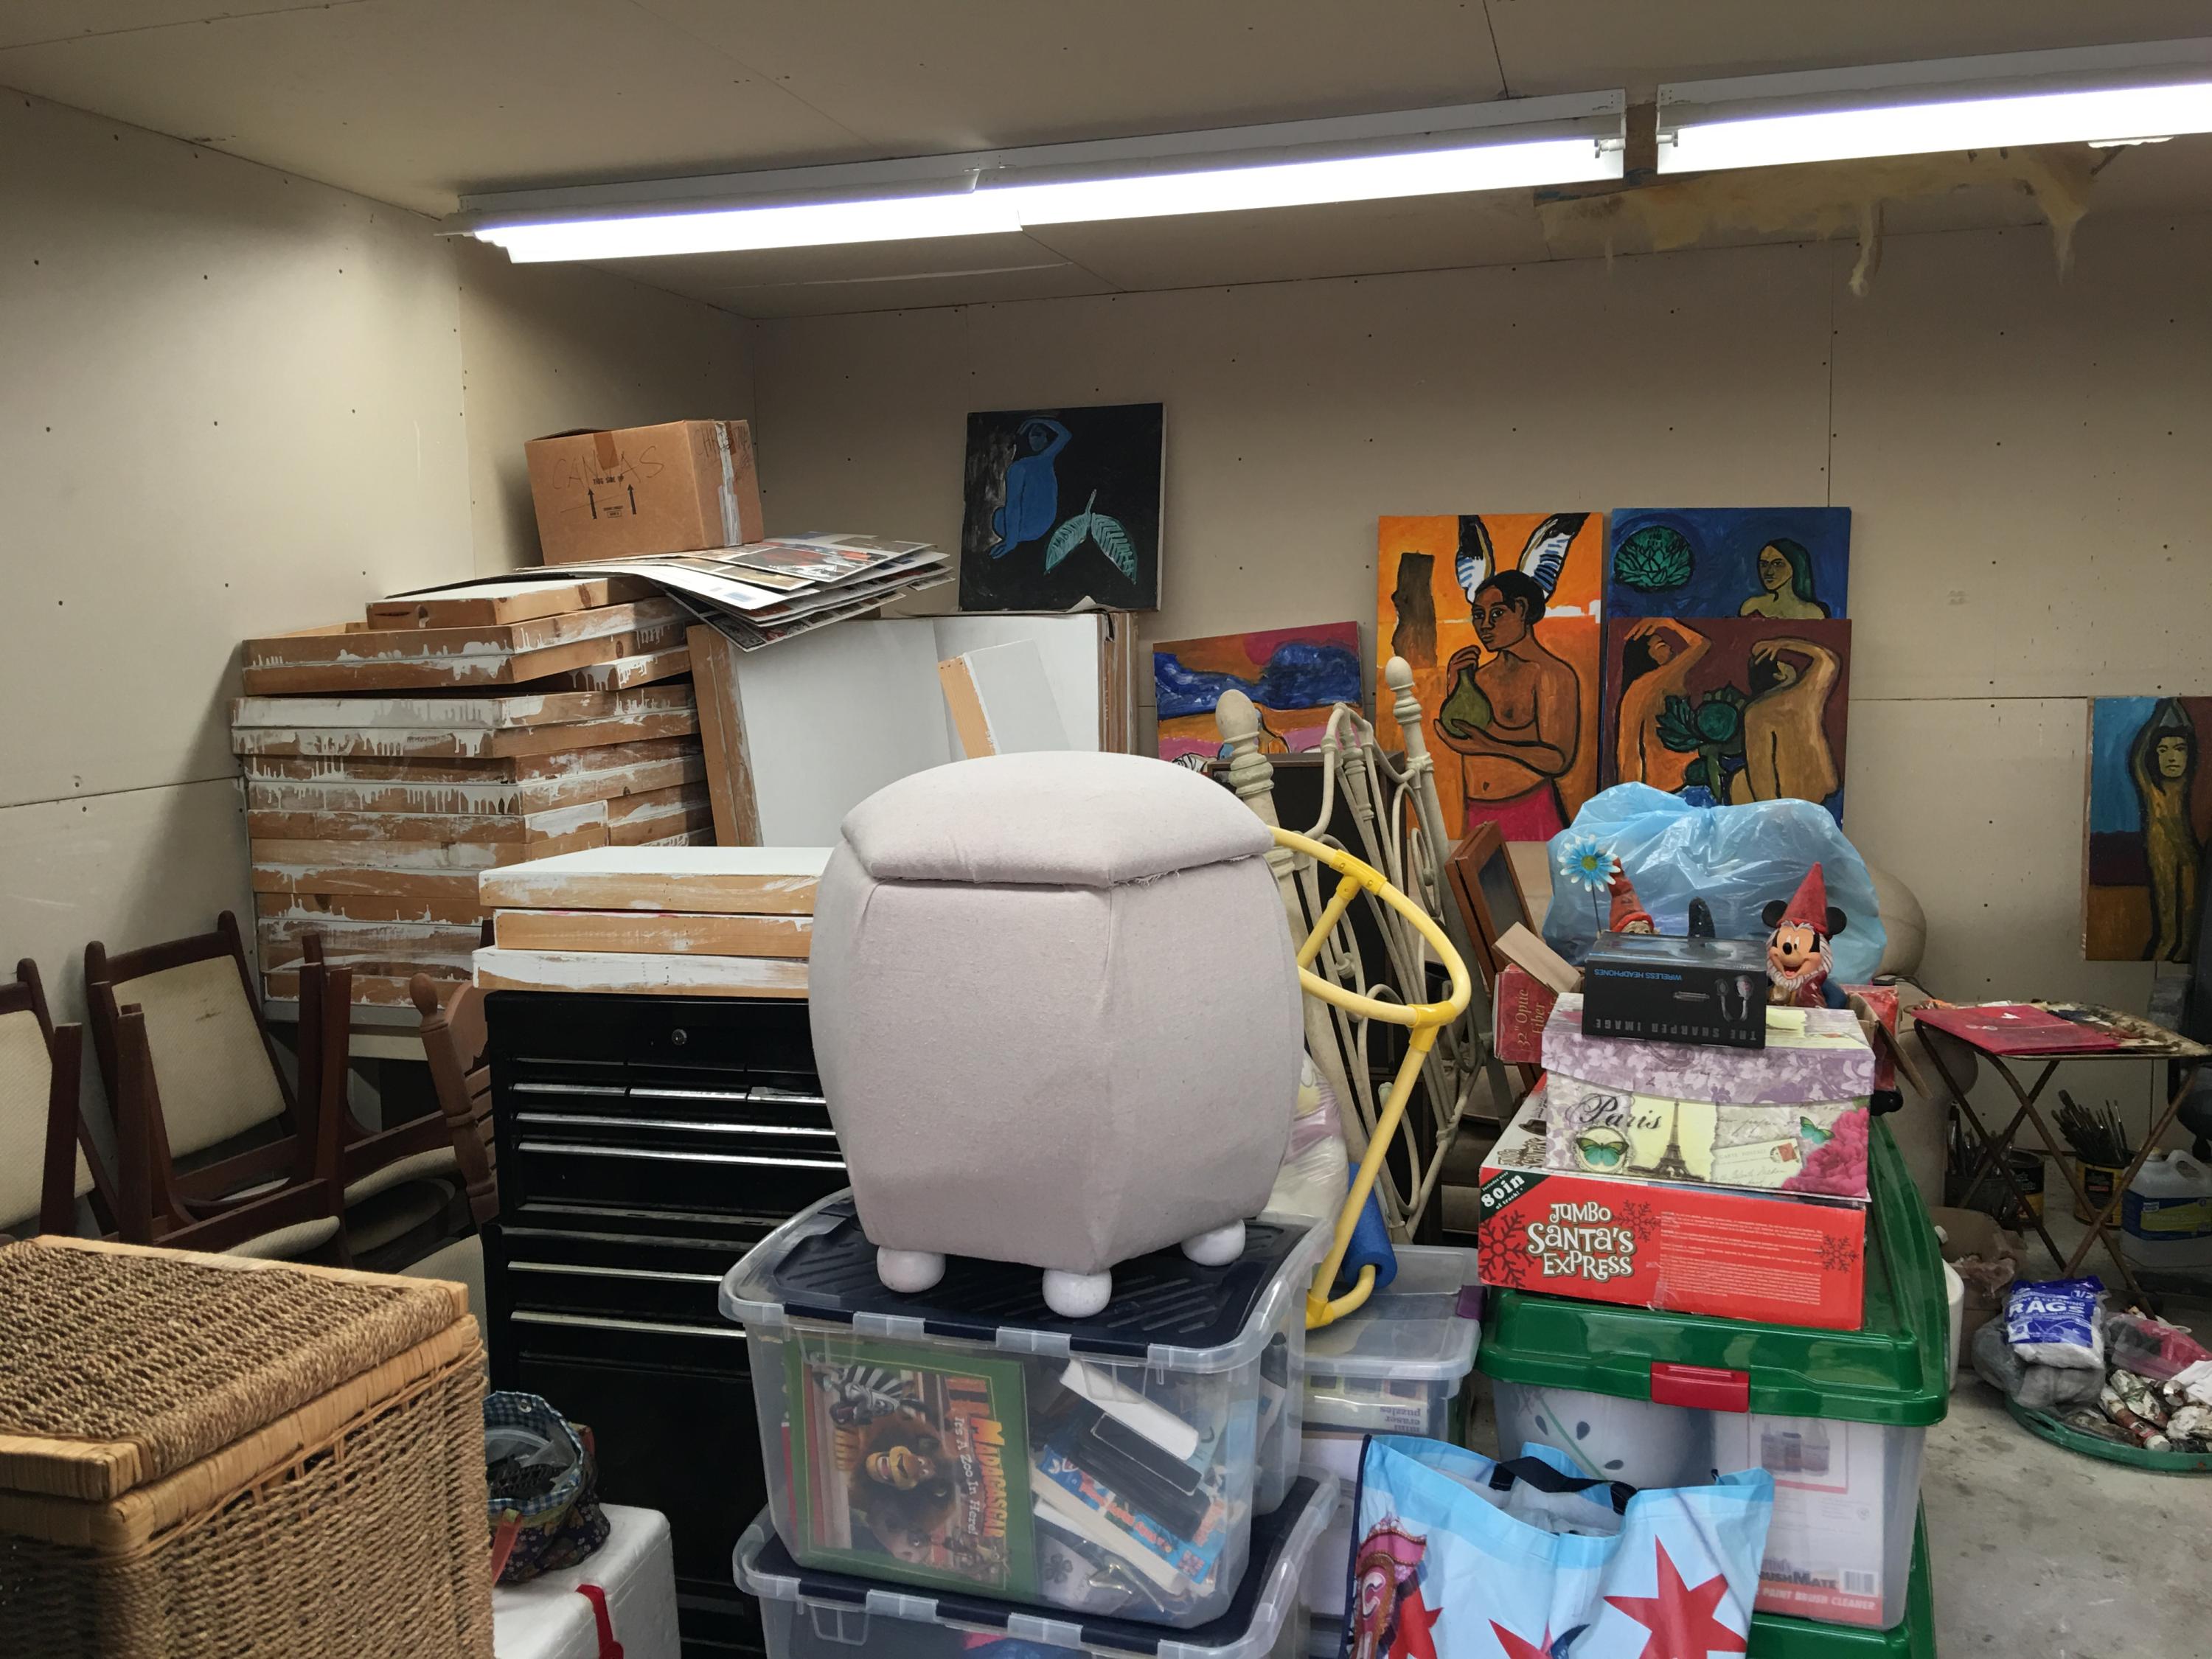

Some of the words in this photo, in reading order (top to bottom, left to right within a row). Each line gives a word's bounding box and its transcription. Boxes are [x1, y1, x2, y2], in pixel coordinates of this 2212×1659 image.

[1594, 969, 1644, 978] HEADPHONES
[1644, 973, 1683, 981] WIRELESS
[1515, 989, 1532, 1023] Optic
[1531, 1003, 1545, 1034] Fiber
[1596, 1018, 1641, 1032] IMAGE
[1514, 1026, 1531, 1047] 32"
[1652, 1023, 1719, 1037] SHARPER
[1730, 1029, 1756, 1040] THE
[1565, 1093, 1662, 1130] Paris
[1549, 1202, 1611, 1223] JUMBO
[1527, 1222, 1634, 1254] SANTA'S
[1543, 1251, 1632, 1281] EXPRESS
[2008, 1300, 2086, 1318] RAGS
[1380, 1405, 1421, 1417] puzzles
[954, 1416, 965, 1436] It's
[958, 1439, 968, 1450] A
[960, 1453, 973, 1478] Zoo
[967, 1480, 979, 1495] In
[970, 1416, 1008, 1538] MADAGASCAR
[968, 1500, 981, 1536] Here!
[1763, 1587, 1792, 1600] PAINT
[1795, 1590, 1829, 1604] BRUSH
[1831, 1596, 1877, 1610] CLEANER
